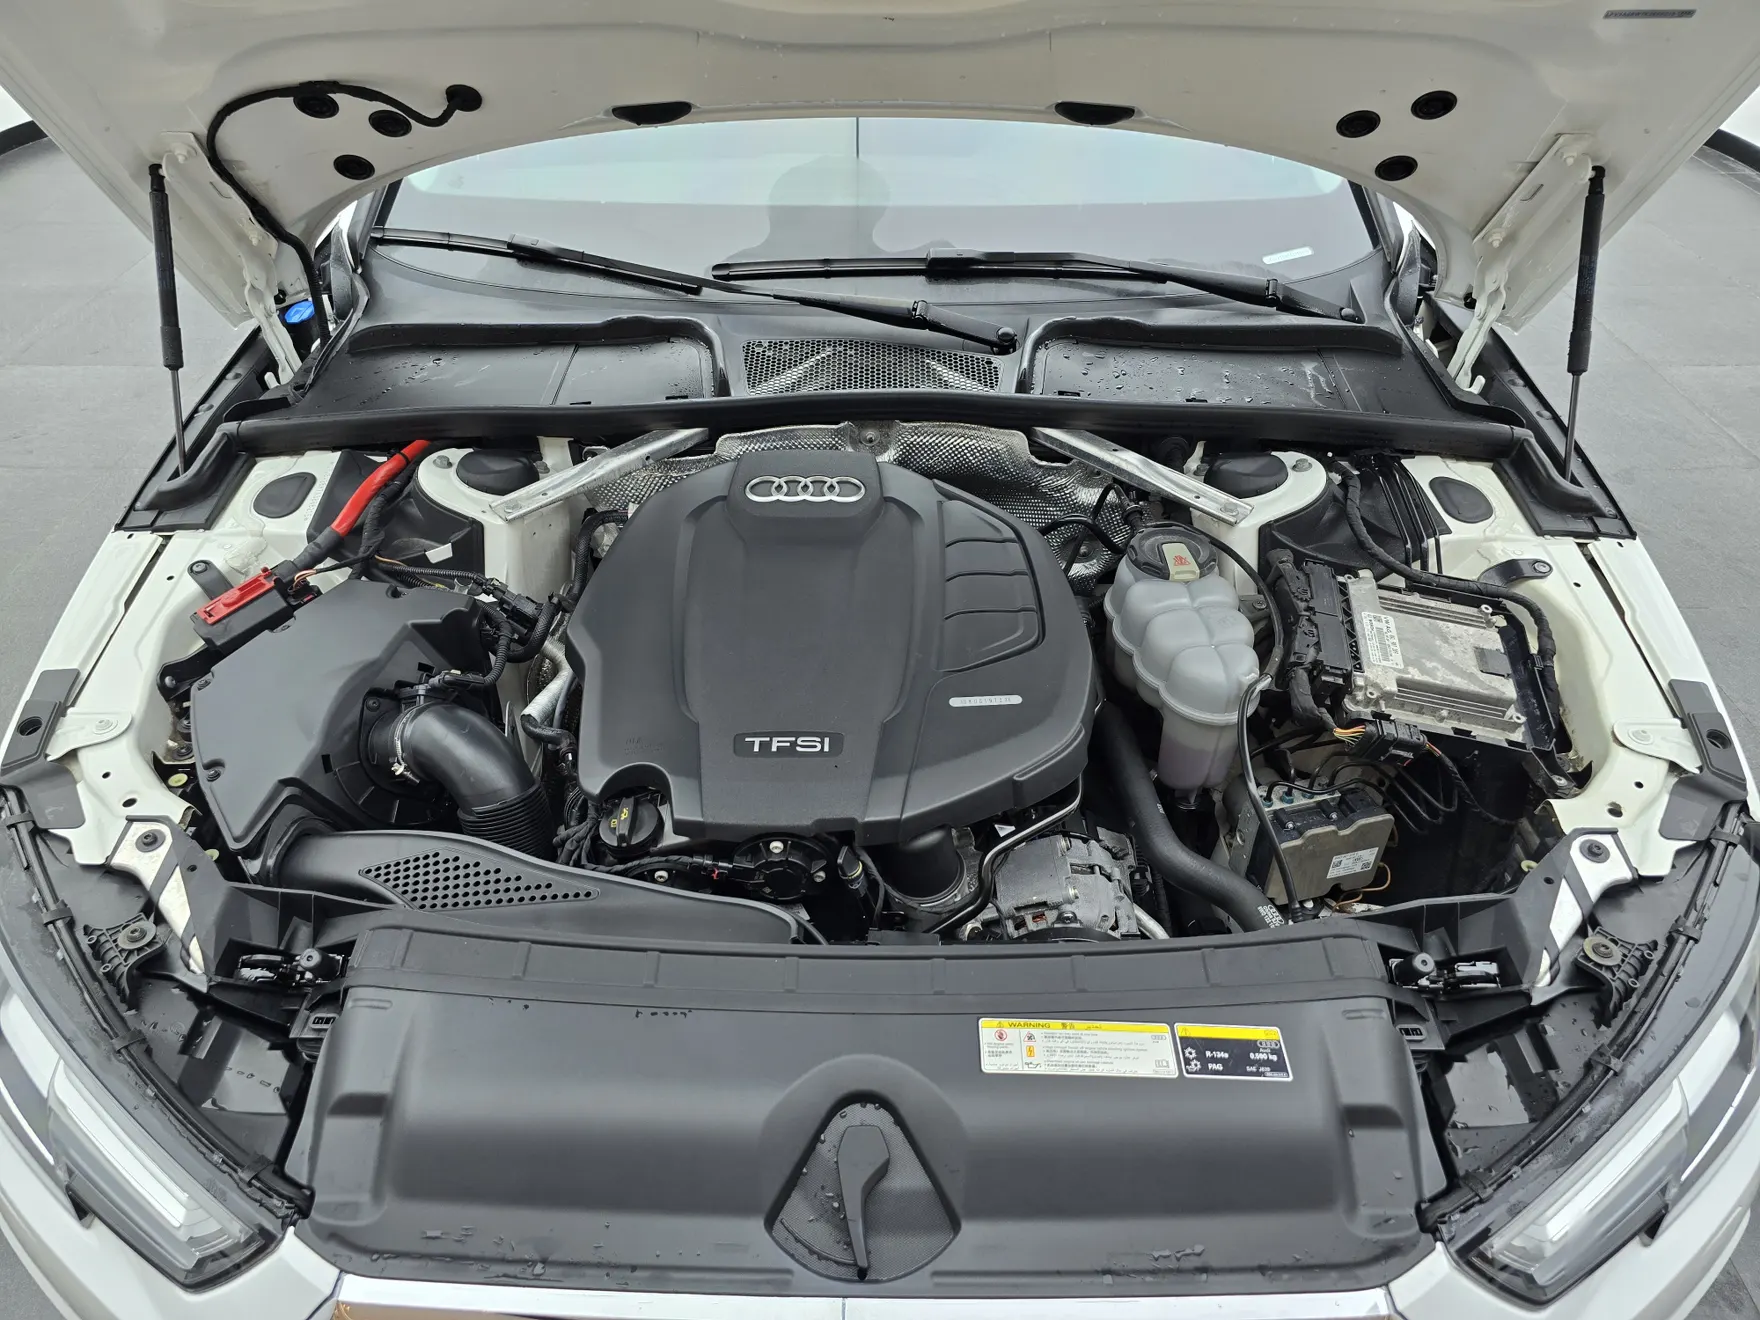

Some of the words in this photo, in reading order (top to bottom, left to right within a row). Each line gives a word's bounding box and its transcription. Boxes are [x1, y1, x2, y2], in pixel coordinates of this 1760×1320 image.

[744, 736, 830, 752] TFSI
[1007, 1021, 1051, 1029] WARNING
[1205, 1050, 1229, 1059] R-134a
[1268, 1053, 1278, 1062] kg
[1207, 1063, 1224, 1071] PAG
